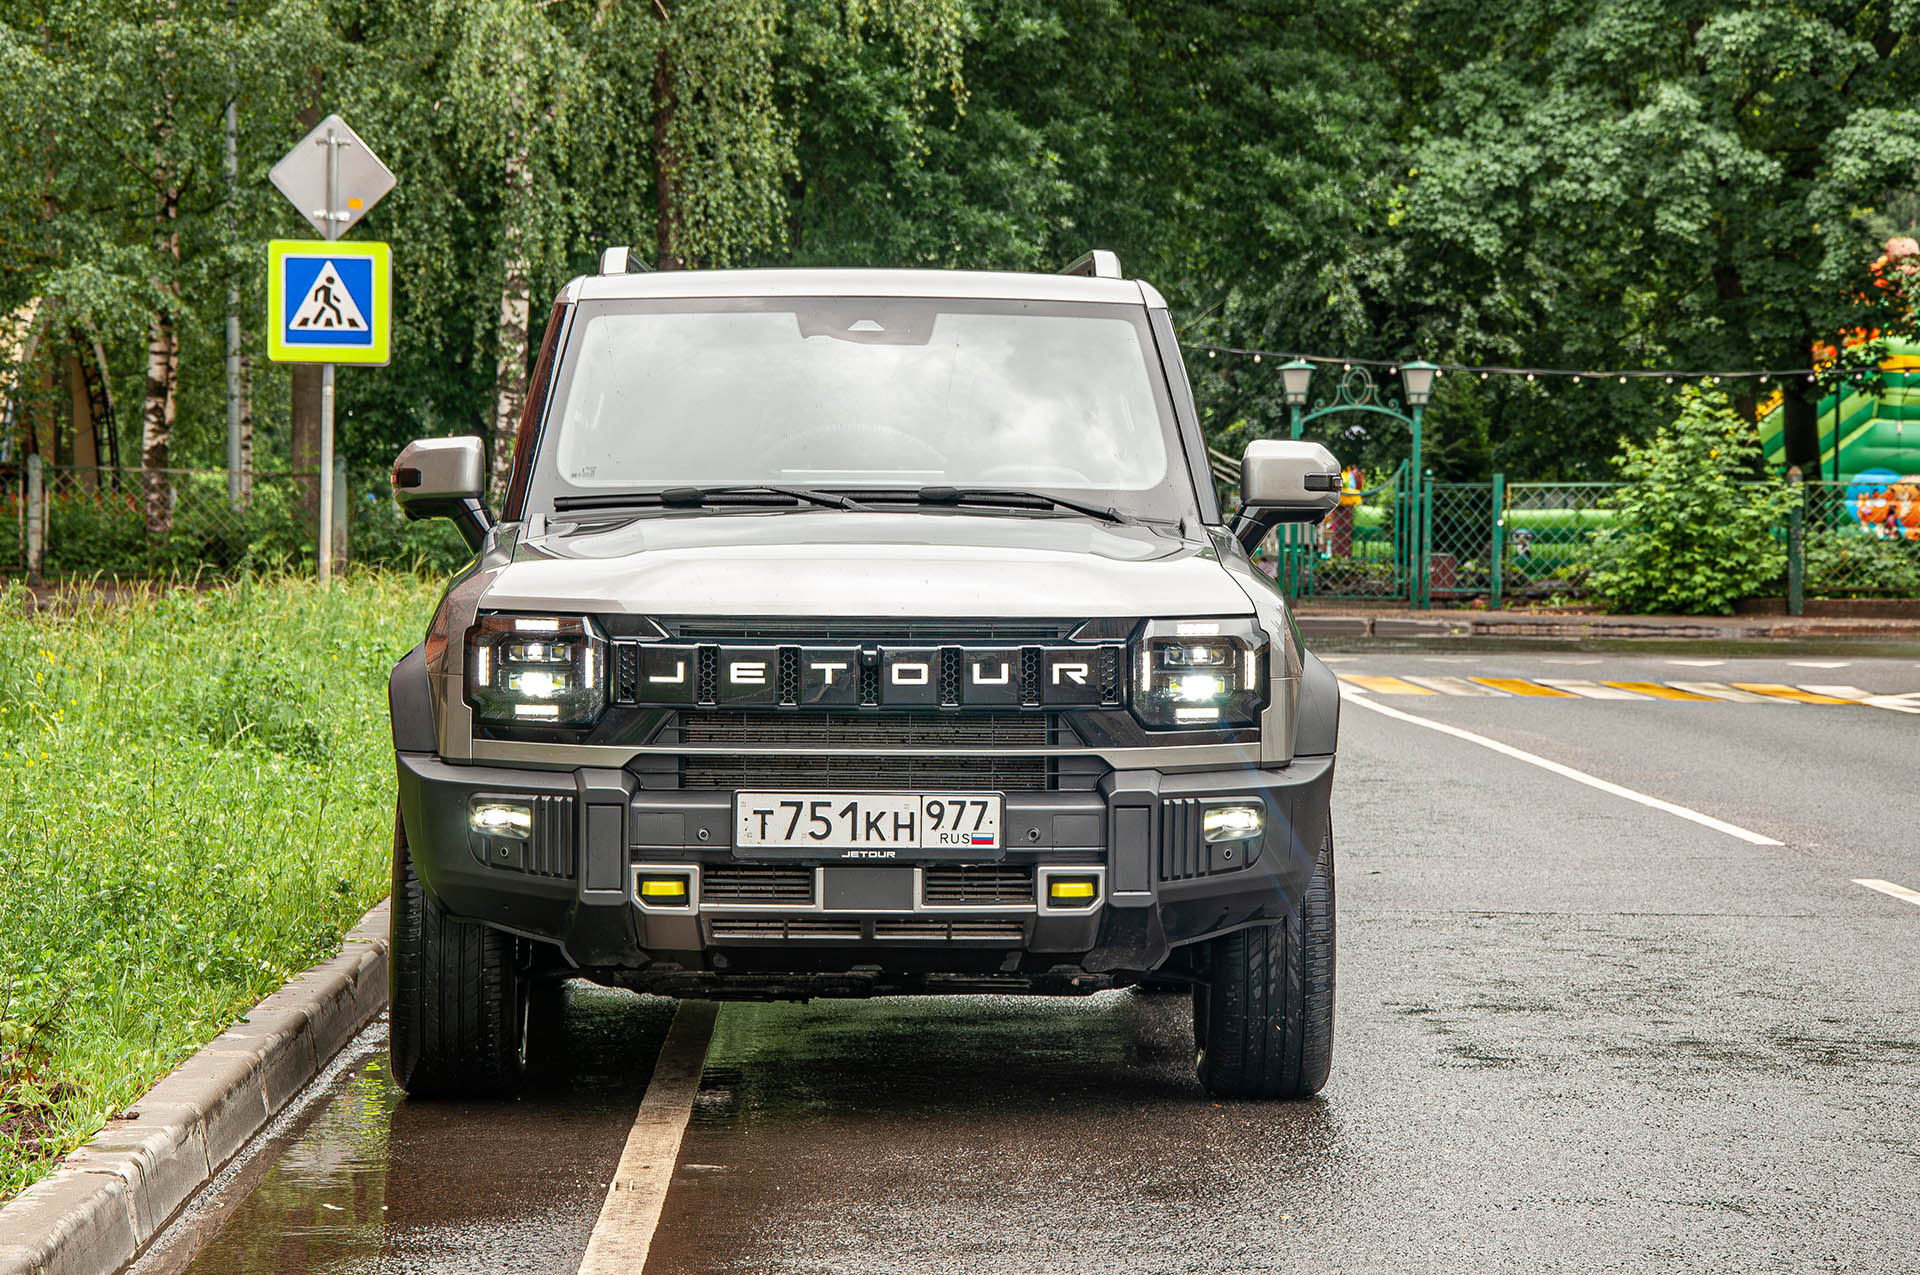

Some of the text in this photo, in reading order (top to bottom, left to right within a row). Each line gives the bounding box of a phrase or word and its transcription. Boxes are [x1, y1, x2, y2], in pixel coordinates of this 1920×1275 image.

[649, 662, 1089, 685] JETOUR
[926, 799, 989, 831] 977
[940, 833, 970, 844] RUS
[841, 851, 896, 859] JETOUR
